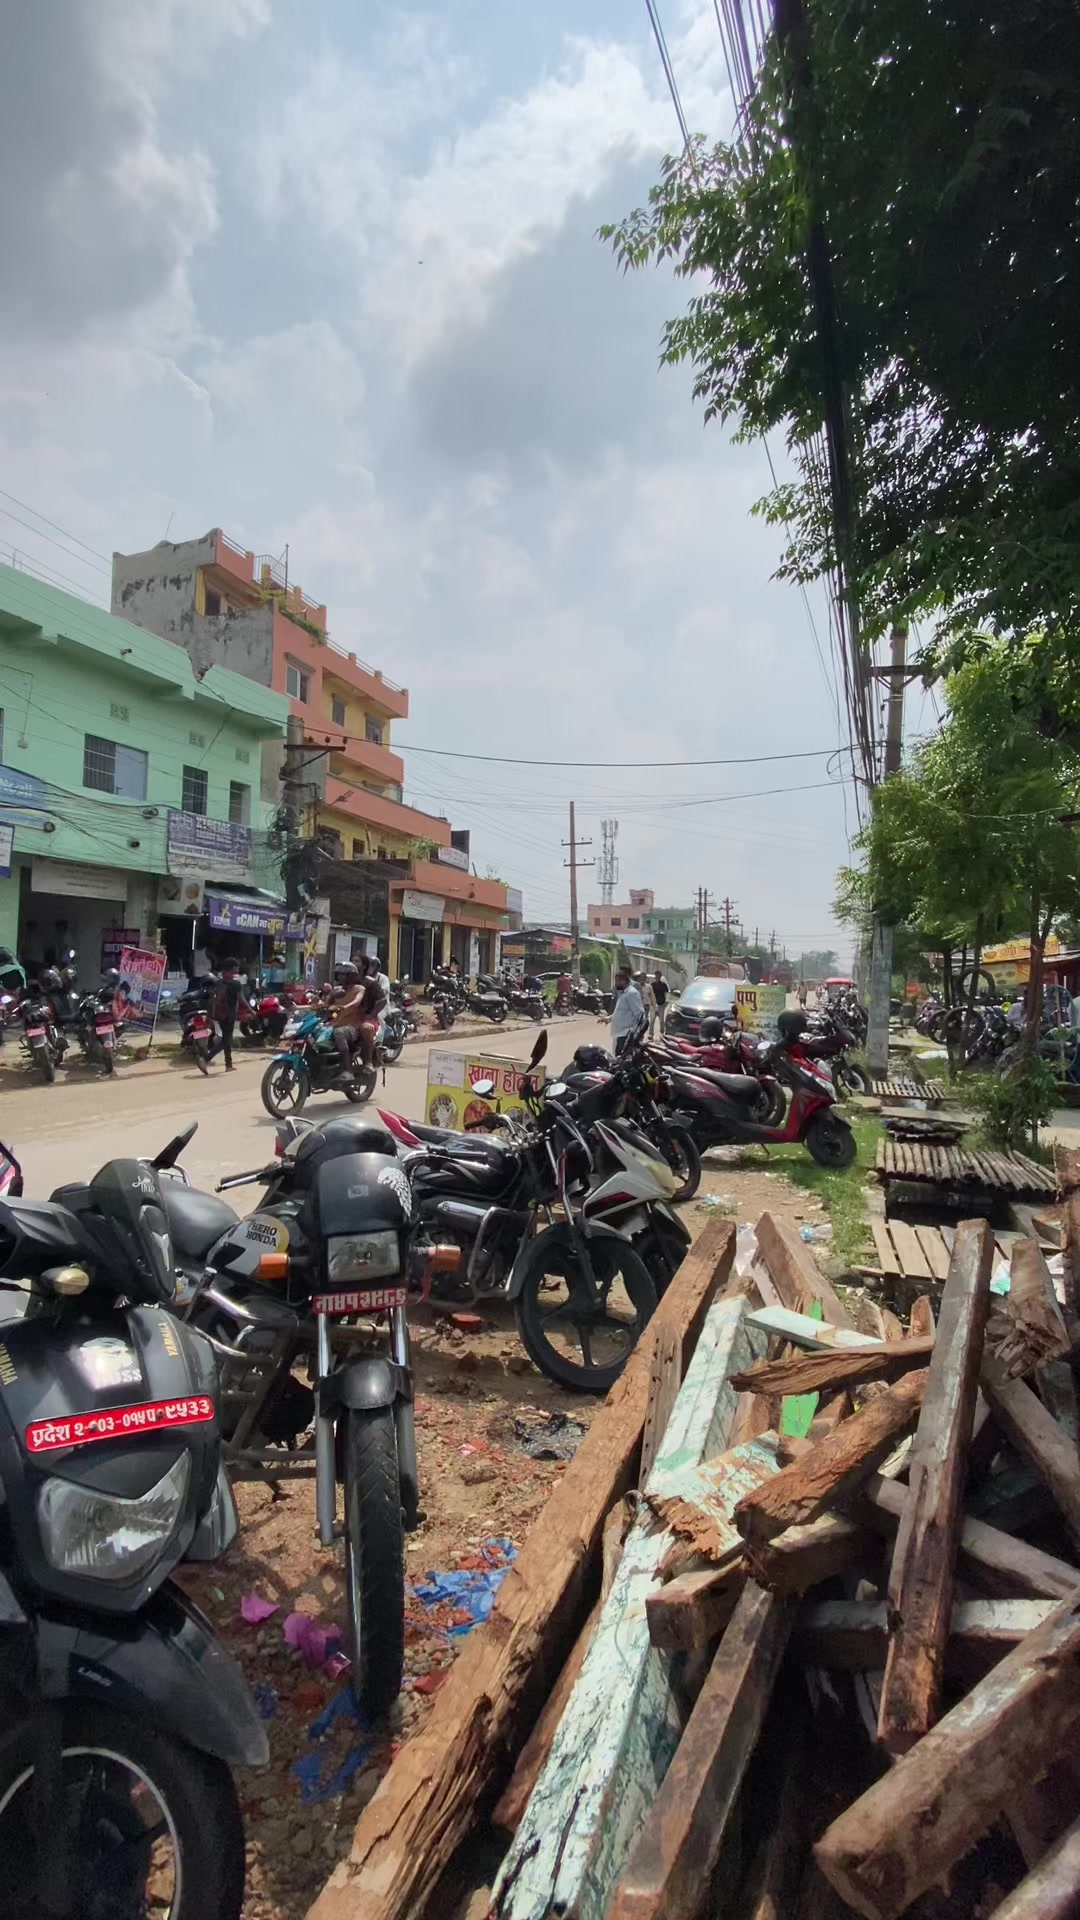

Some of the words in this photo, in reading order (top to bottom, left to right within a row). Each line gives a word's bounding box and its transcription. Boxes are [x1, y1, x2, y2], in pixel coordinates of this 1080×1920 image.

[252, 1222, 277, 1236] HERO
[245, 1230, 277, 1247] HONDA
[32, 1423, 70, 1447] प्रदेश
